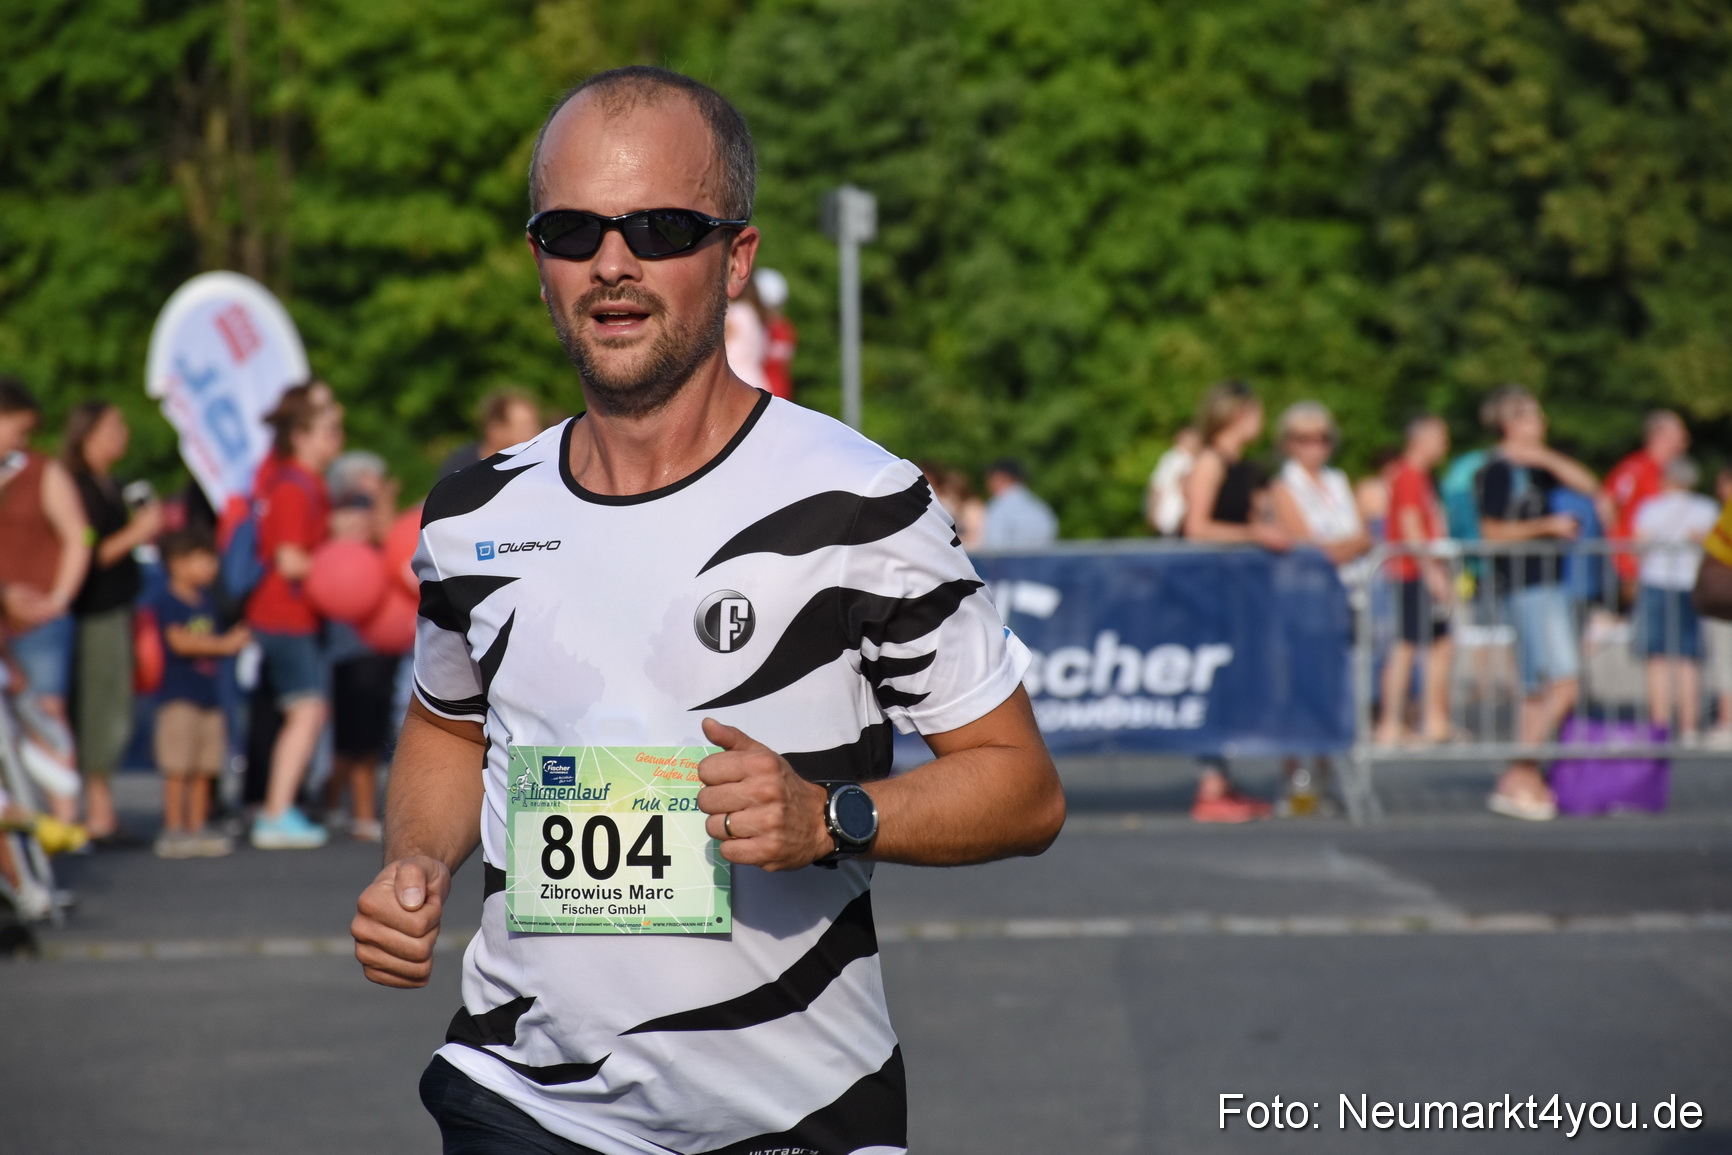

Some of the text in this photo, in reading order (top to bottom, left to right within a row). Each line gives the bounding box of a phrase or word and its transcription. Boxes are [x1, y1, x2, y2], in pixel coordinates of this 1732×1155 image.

[635, 752, 677, 767] Gesunde
[653, 766, 683, 780] laufen
[531, 782, 611, 800] firmenlauf
[667, 797, 700, 811] 201
[541, 815, 671, 880] 804
[540, 884, 674, 900] Zibrowius Marc
[561, 904, 646, 915] Fischer GmbH
